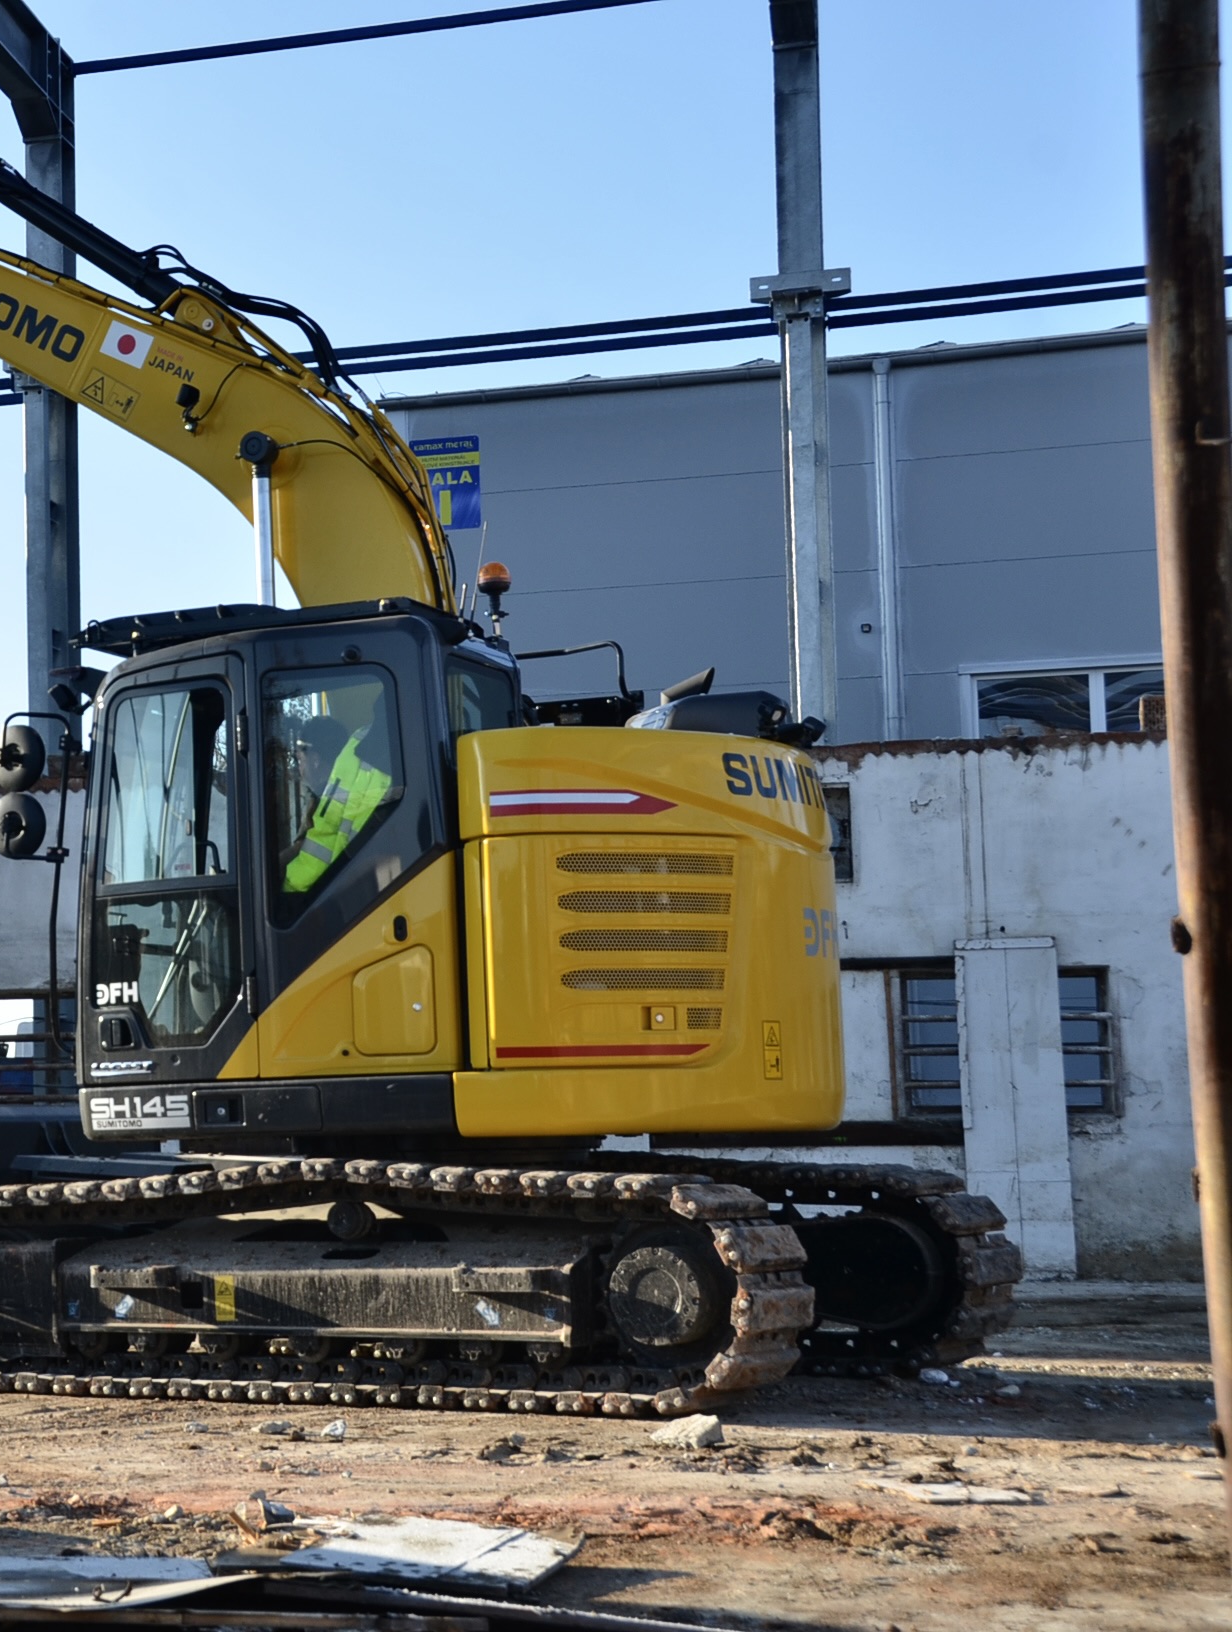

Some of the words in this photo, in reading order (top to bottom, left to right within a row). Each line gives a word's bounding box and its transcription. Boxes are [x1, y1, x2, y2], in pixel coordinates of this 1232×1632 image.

[148, 356, 194, 382] JAPAN
[432, 470, 473, 486] ALA
[96, 981, 139, 1006] DFH
[90, 1094, 189, 1119] SH145
[96, 1119, 143, 1129] SUMITOMO
